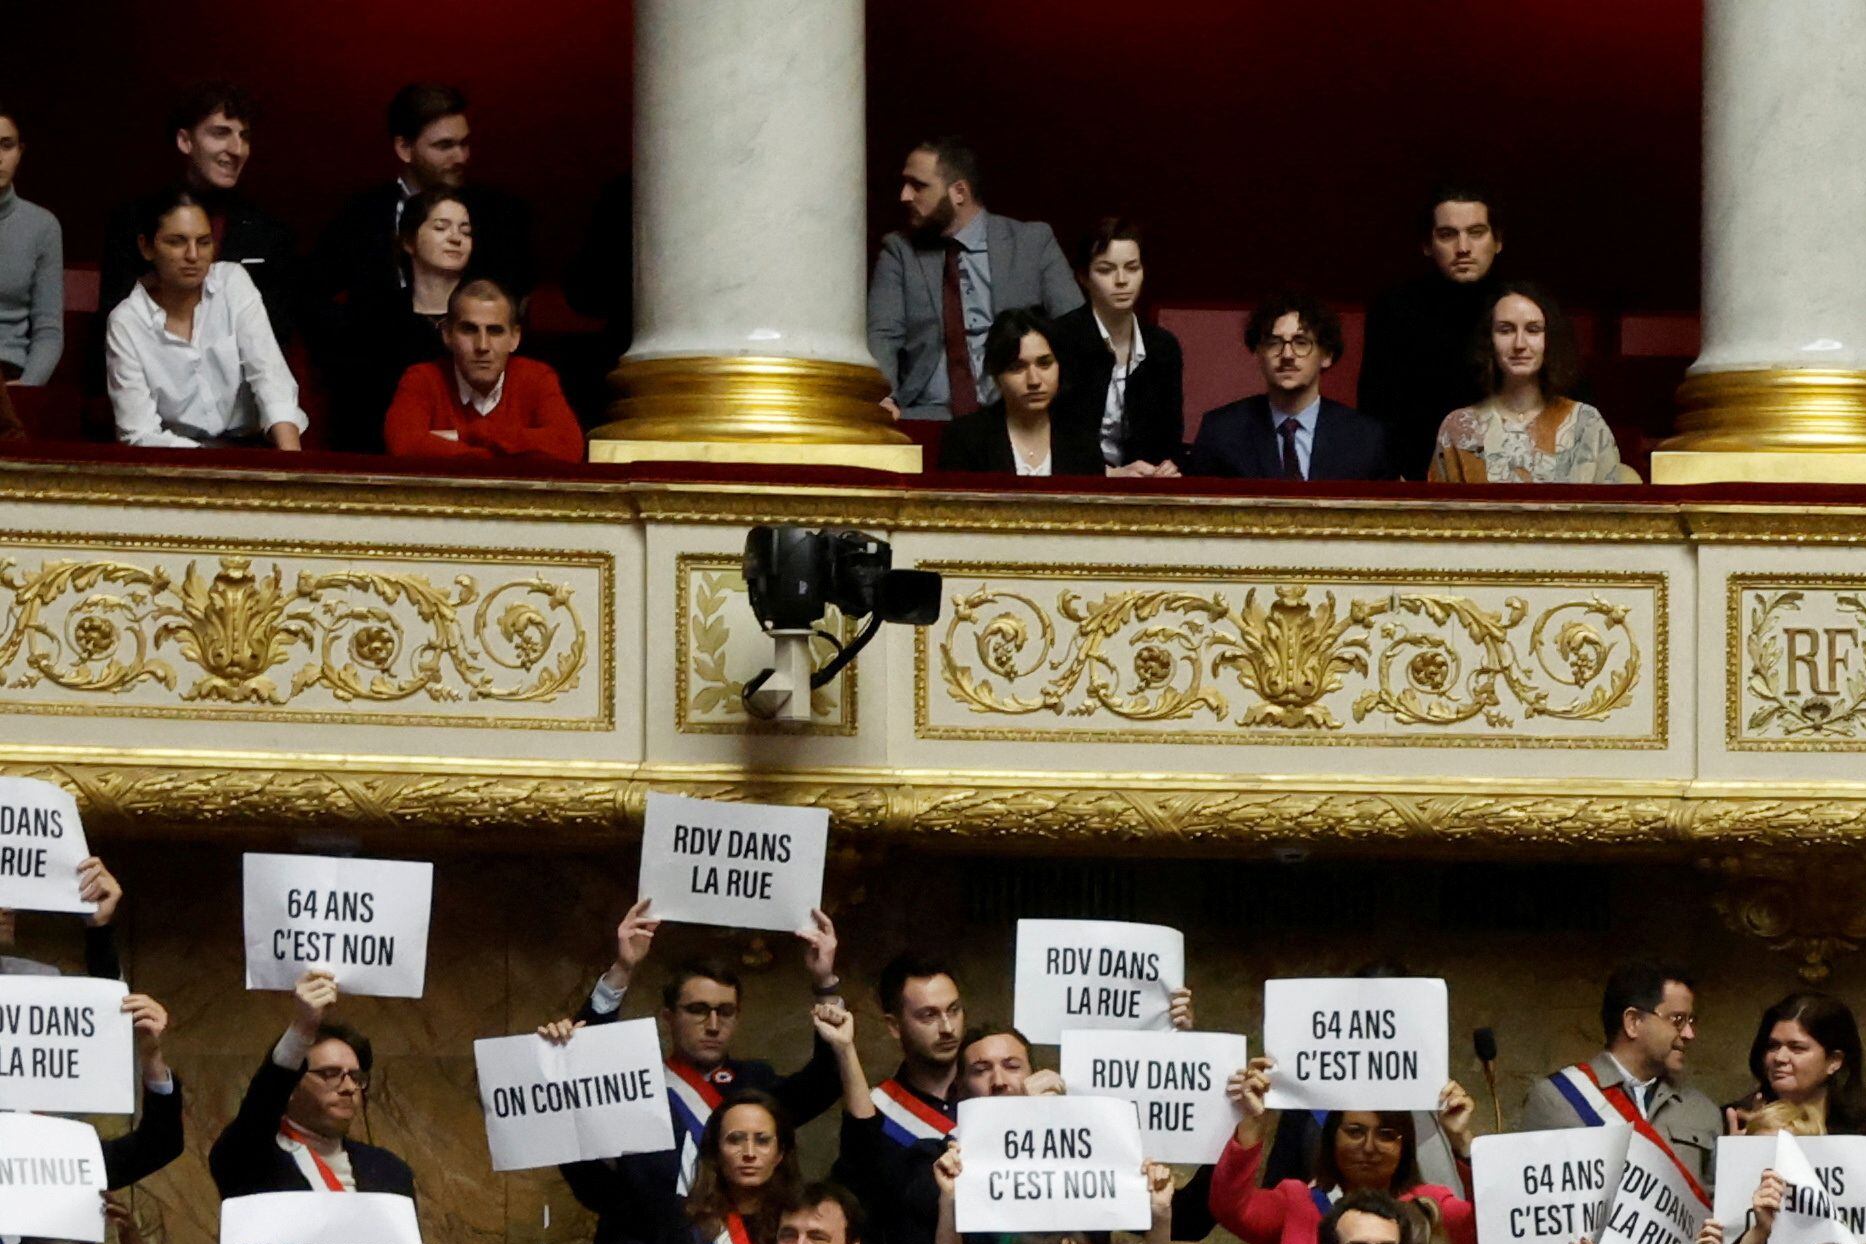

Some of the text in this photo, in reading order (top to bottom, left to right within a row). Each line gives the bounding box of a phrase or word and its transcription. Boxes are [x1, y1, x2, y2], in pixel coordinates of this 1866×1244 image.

[1782, 627, 1859, 698] RF
[0, 805, 64, 839] DANS
[673, 824, 792, 864] RDV DANS
[0, 846, 48, 878] RUE
[691, 865, 773, 901] LA RUE
[287, 888, 375, 924] 64 ANS
[272, 927, 395, 967] C'EST NON
[1046, 947, 1161, 983] RDV DANS
[1066, 986, 1142, 1019] LA RUE
[29, 1005, 96, 1038] DANS
[1312, 1009, 1396, 1040] 64 ANS
[32, 1047, 80, 1079] RUE
[1092, 1058, 1212, 1092] RDV DANS
[1296, 1049, 1418, 1082] C'EST NON
[493, 1068, 655, 1119] ON CONTINUE
[1148, 1101, 1195, 1132] RUE
[1004, 1127, 1093, 1160] 64 ANS
[988, 1169, 1117, 1202] C'EST NON
[1523, 1158, 1605, 1196] 64 ANS
[1509, 1203, 1576, 1239] C'EST
[1606, 1201, 1637, 1240] LA
[1653, 1186, 1696, 1240] DANS
